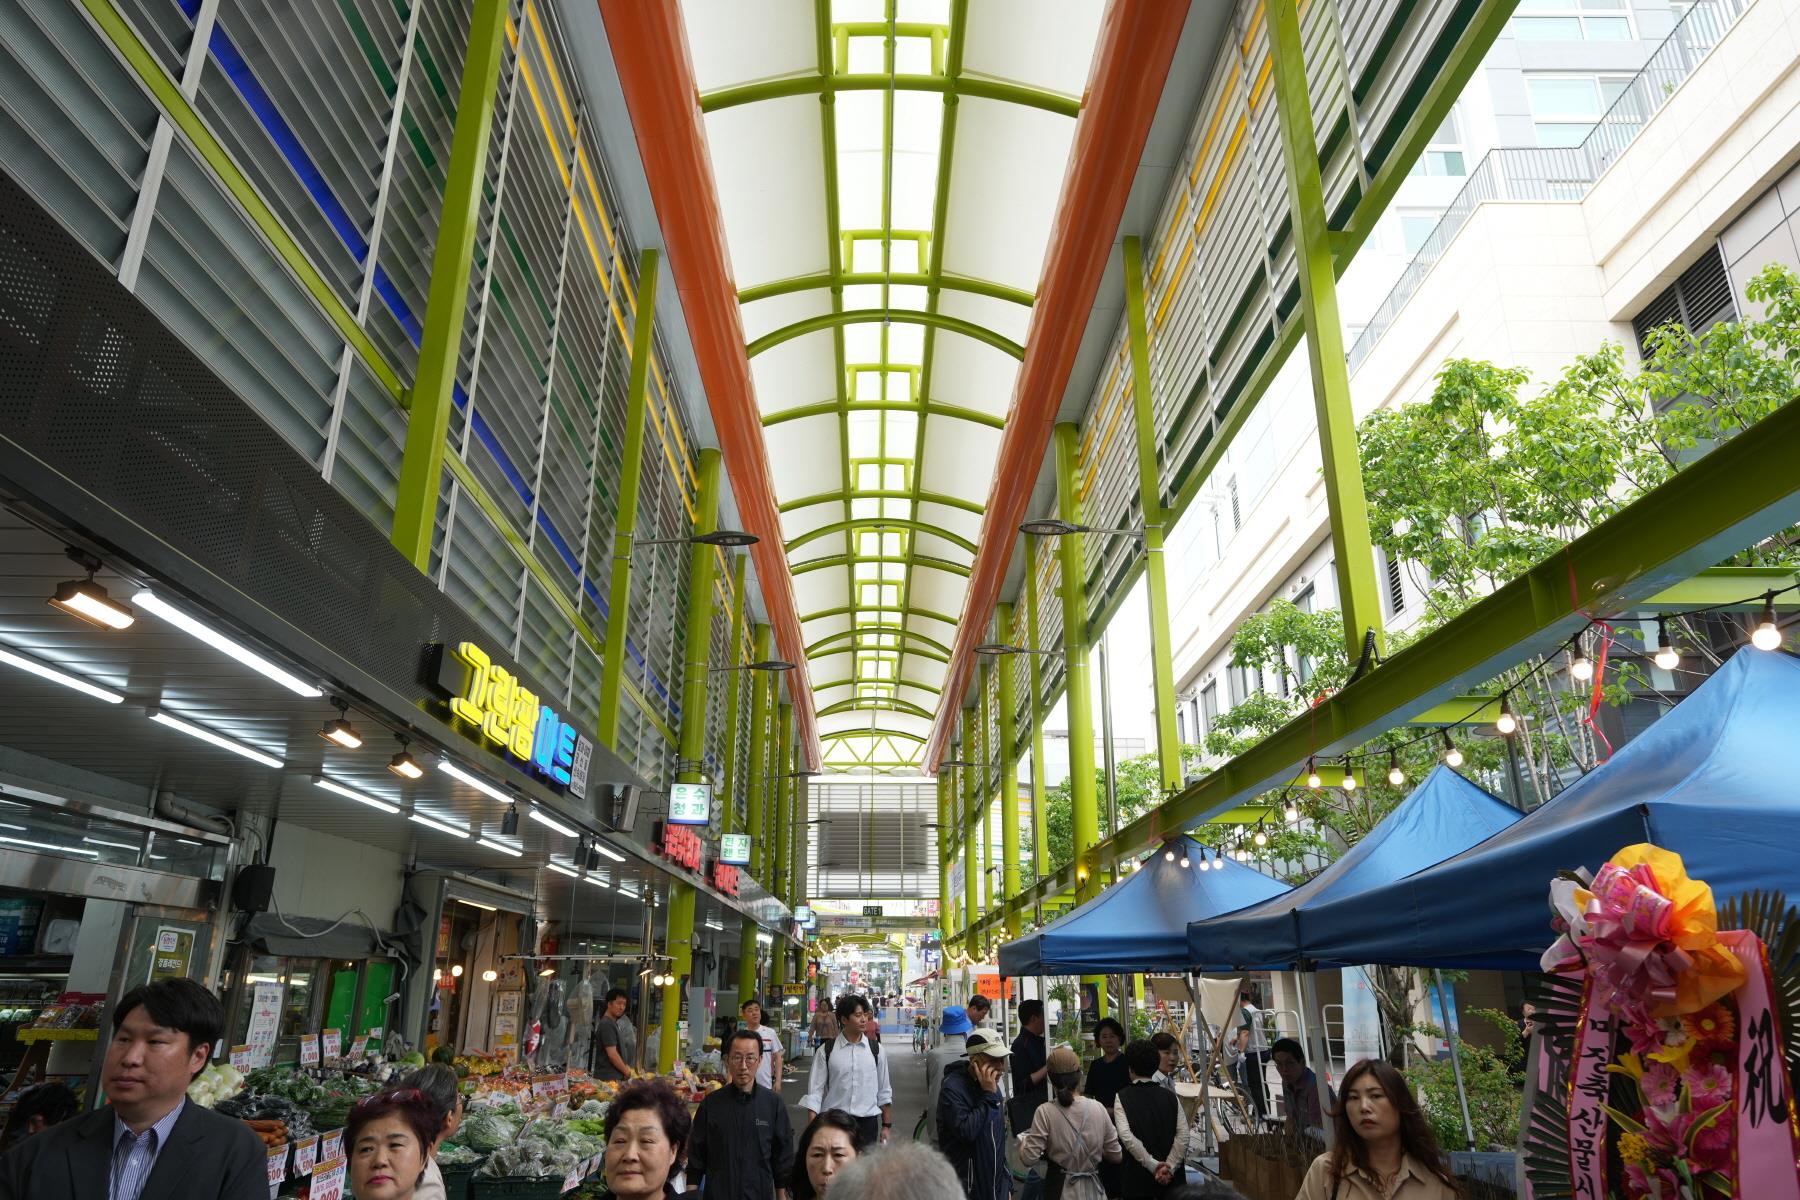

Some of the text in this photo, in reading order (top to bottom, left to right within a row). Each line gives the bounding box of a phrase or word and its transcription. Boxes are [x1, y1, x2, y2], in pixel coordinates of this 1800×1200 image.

[674, 802, 705, 815] 청과
[863, 907, 877, 915] GATE
[1742, 1008, 1788, 1128] 祝
